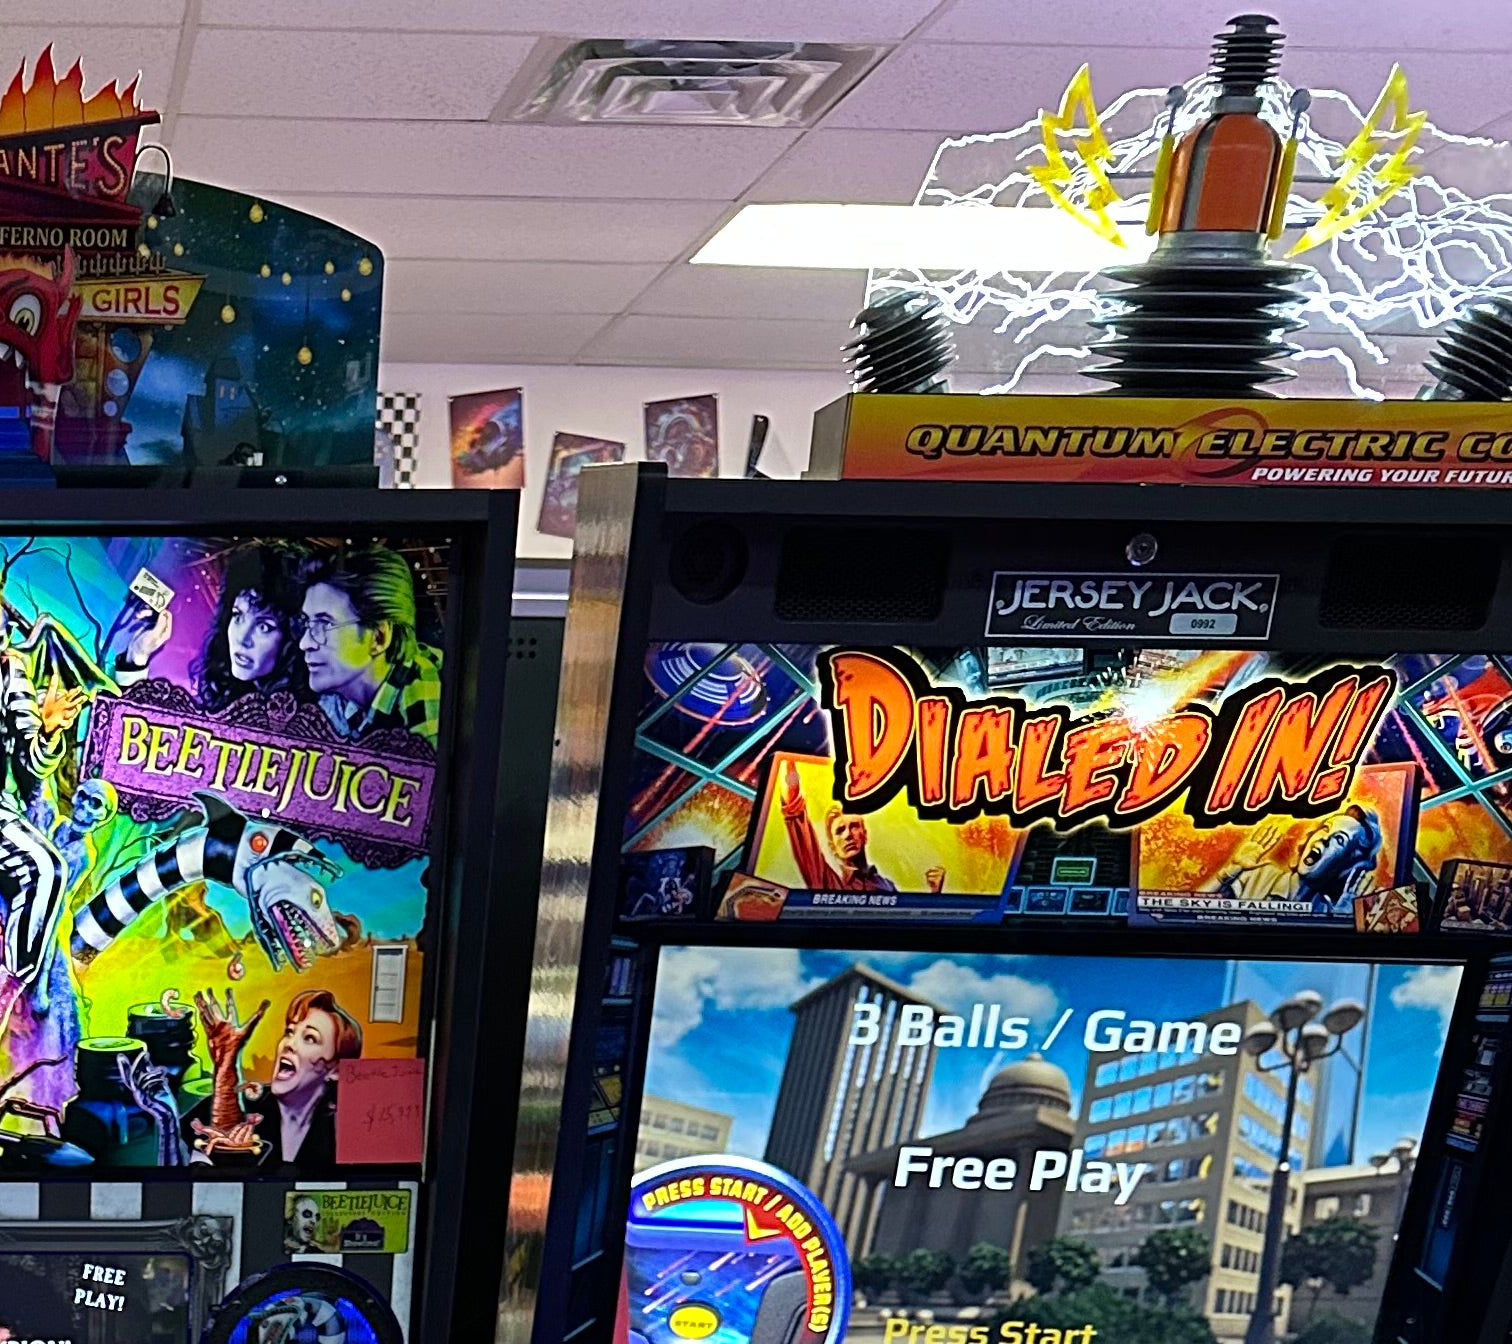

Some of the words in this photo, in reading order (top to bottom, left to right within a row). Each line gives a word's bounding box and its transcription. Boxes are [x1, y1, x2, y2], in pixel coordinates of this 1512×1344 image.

[70, 226, 128, 248] ROOM
[92, 284, 180, 314] GIRLS
[905, 424, 1178, 458] QUANTUM
[1194, 427, 1446, 462] ELECTRIC
[1251, 467, 1375, 483] POWERING
[1379, 468, 1441, 484] YOUR
[1002, 579, 1152, 615] JERSEY
[1148, 581, 1259, 617] JACK
[1021, 614, 1076, 632] Limited
[1082, 615, 1137, 633] Edition
[1190, 618, 1217, 630] 0992
[828, 648, 1214, 818] DIALED
[1204, 674, 1393, 814] IN!
[119, 714, 424, 829] BEETLEJUICE
[812, 894, 867, 906] BREAKING
[868, 895, 898, 906] NEWS
[1142, 897, 1176, 908] THE
[1179, 899, 1212, 909] SKY
[1217, 900, 1233, 909] IS
[1238, 901, 1311, 912] FALLING!
[848, 1002, 880, 1048] 3
[896, 1002, 1031, 1051] Balls
[1041, 1007, 1073, 1052] /
[1085, 1008, 1242, 1057] Game
[894, 1147, 1015, 1192] Free
[1029, 1148, 1148, 1207] Play
[322, 1194, 408, 1211] BEETLEJUICE
[641, 1177, 706, 1212] PRESS
[709, 1176, 769, 1206] START
[775, 1203, 813, 1240] ADD
[801, 1235, 833, 1334] PLAYER(S)
[83, 1263, 127, 1287] FREE
[74, 1287, 126, 1313] PLAY!
[674, 1320, 714, 1329] START
